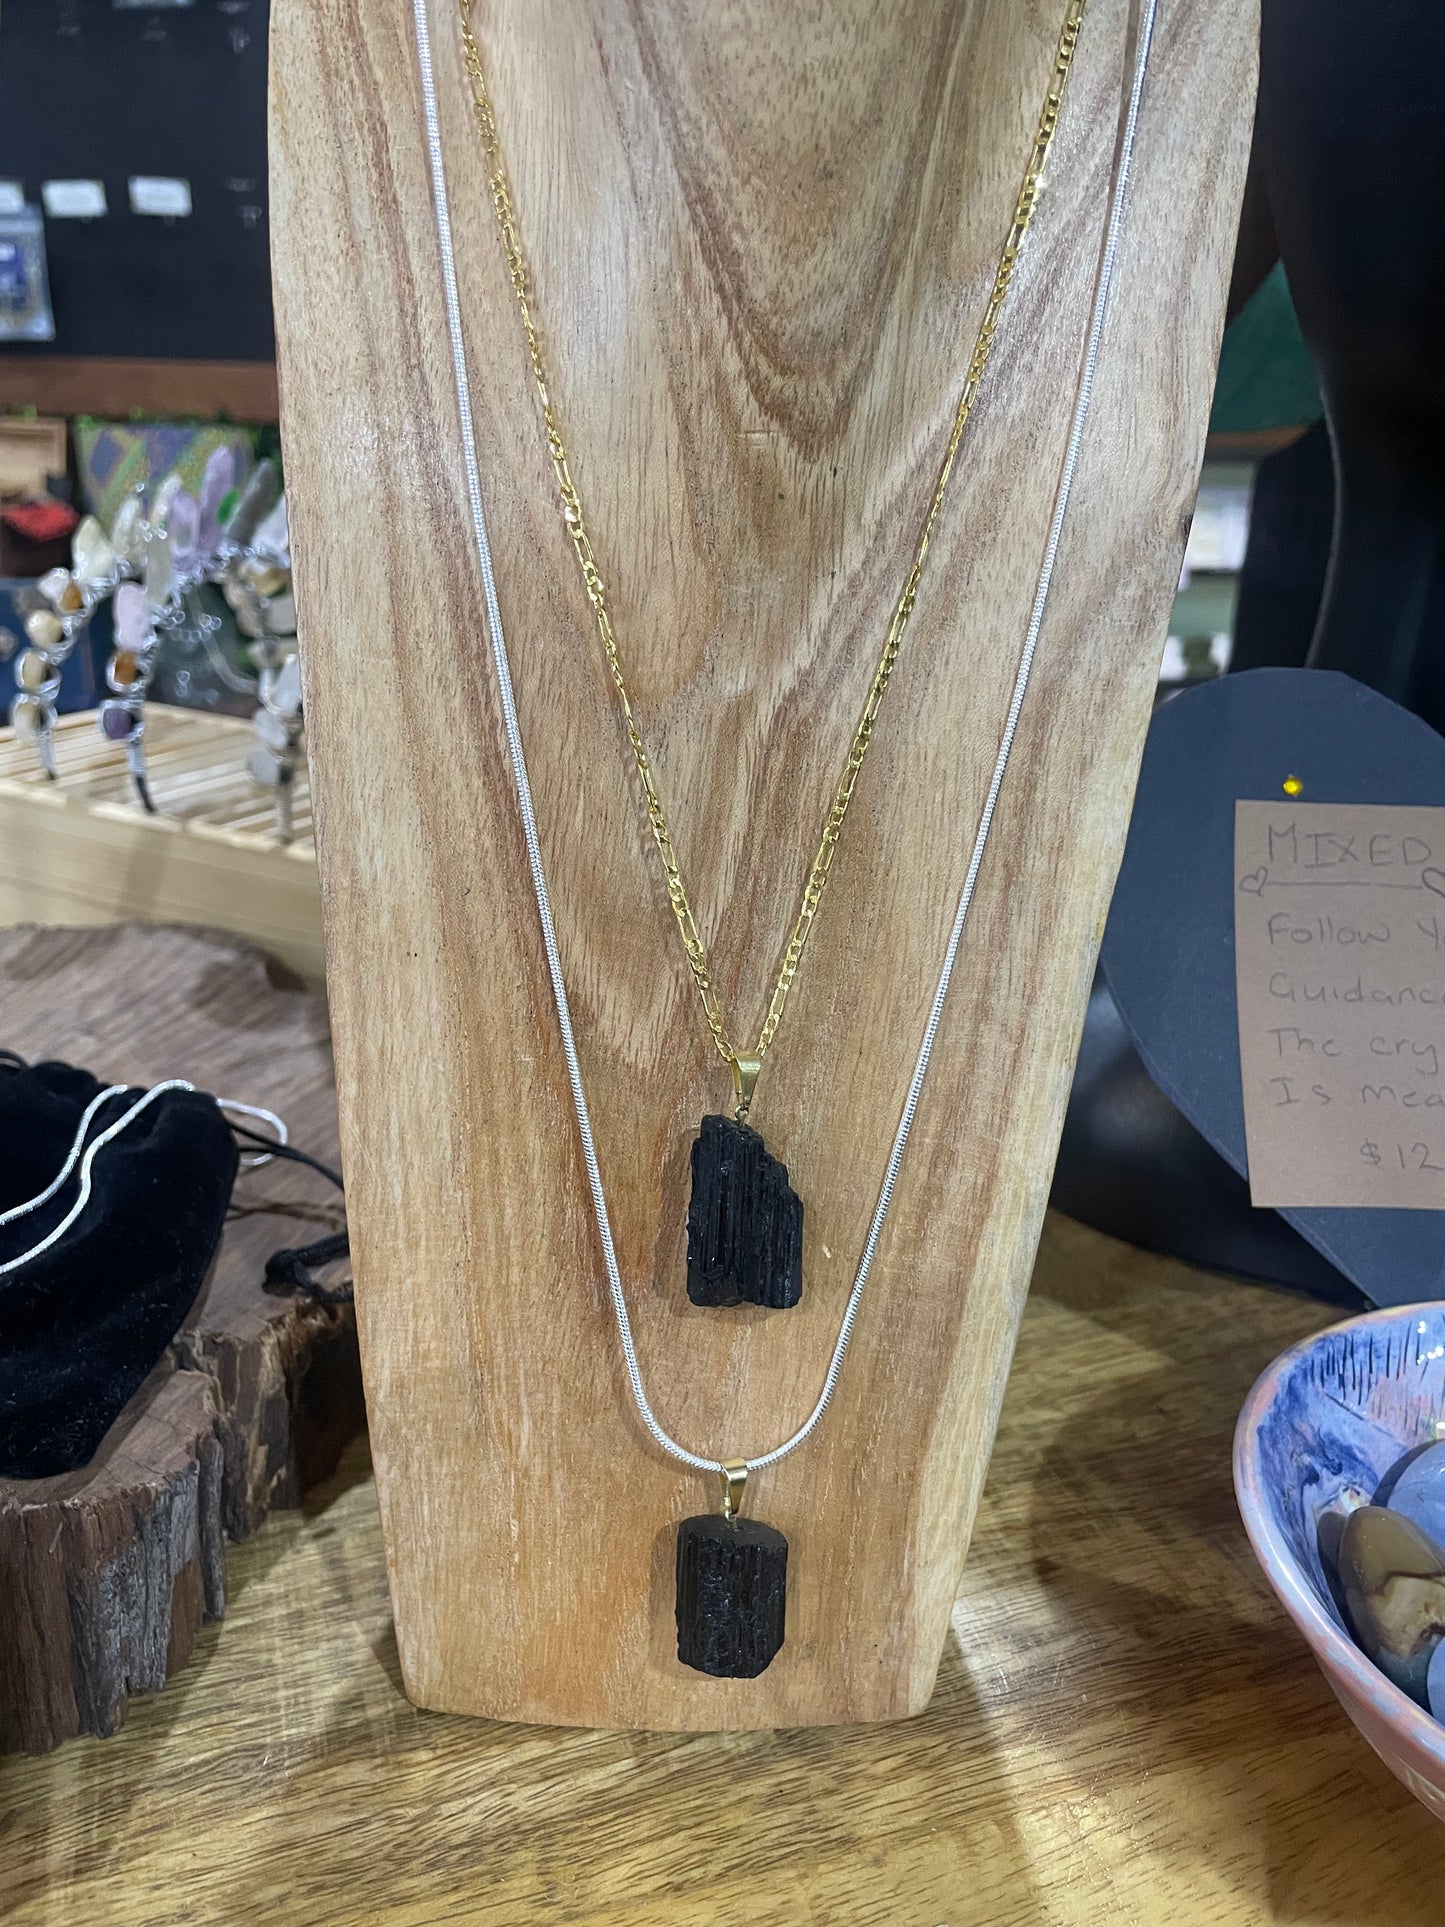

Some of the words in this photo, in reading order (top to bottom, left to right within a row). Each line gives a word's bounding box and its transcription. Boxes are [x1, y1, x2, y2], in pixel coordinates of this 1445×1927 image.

[1268, 823, 1432, 869] MIXED
[1268, 912, 1391, 945] Follow
[1269, 971, 1445, 1006] Guidanc
[1266, 1027, 1342, 1058] The
[1270, 1077, 1332, 1106] Is
